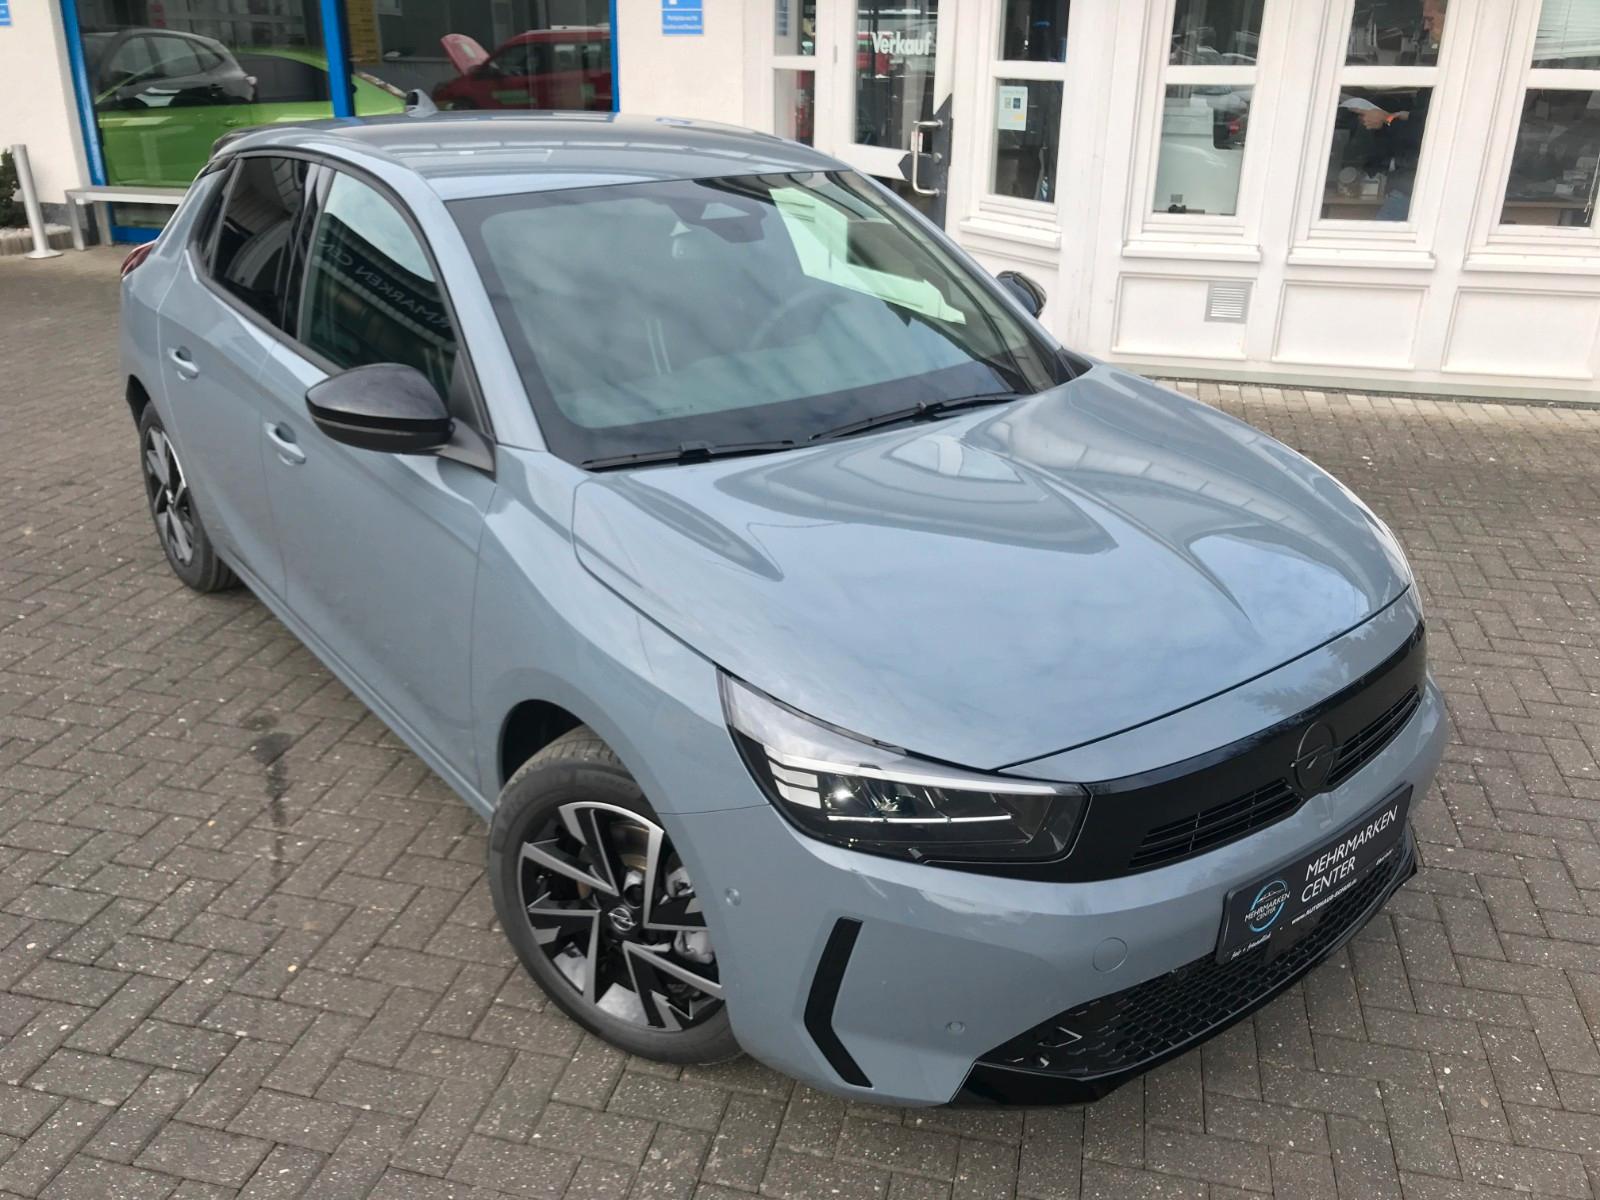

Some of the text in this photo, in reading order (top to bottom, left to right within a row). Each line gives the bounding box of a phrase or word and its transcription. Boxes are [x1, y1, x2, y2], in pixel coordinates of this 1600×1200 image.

[871, 31, 932, 56] Verkauf
[1305, 804, 1398, 881] MEHRMARKEN
[1301, 856, 1356, 903] CENTER
[1244, 891, 1291, 922] MEHRMARKEN
[1256, 906, 1276, 921] CENTER
